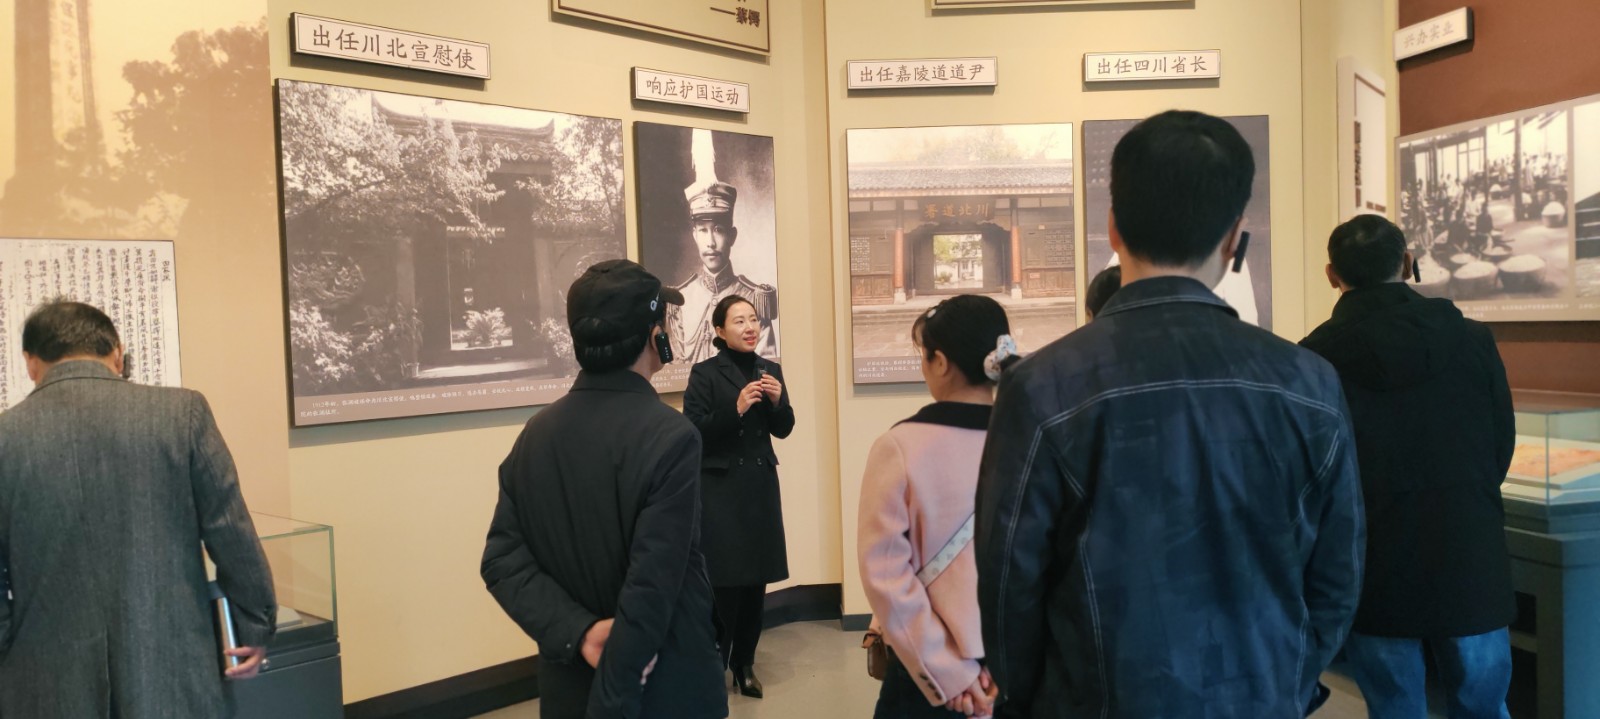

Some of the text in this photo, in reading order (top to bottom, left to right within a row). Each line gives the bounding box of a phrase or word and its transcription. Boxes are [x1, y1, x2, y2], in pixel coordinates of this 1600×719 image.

[312, 23, 477, 71] 出任川北宣慰使
[1403, 20, 1454, 49] 兴办实业
[859, 63, 985, 83] 出任嘉陵道道尹
[1097, 55, 1207, 75] 出任四川省长
[645, 77, 740, 106] 响应护国运动
